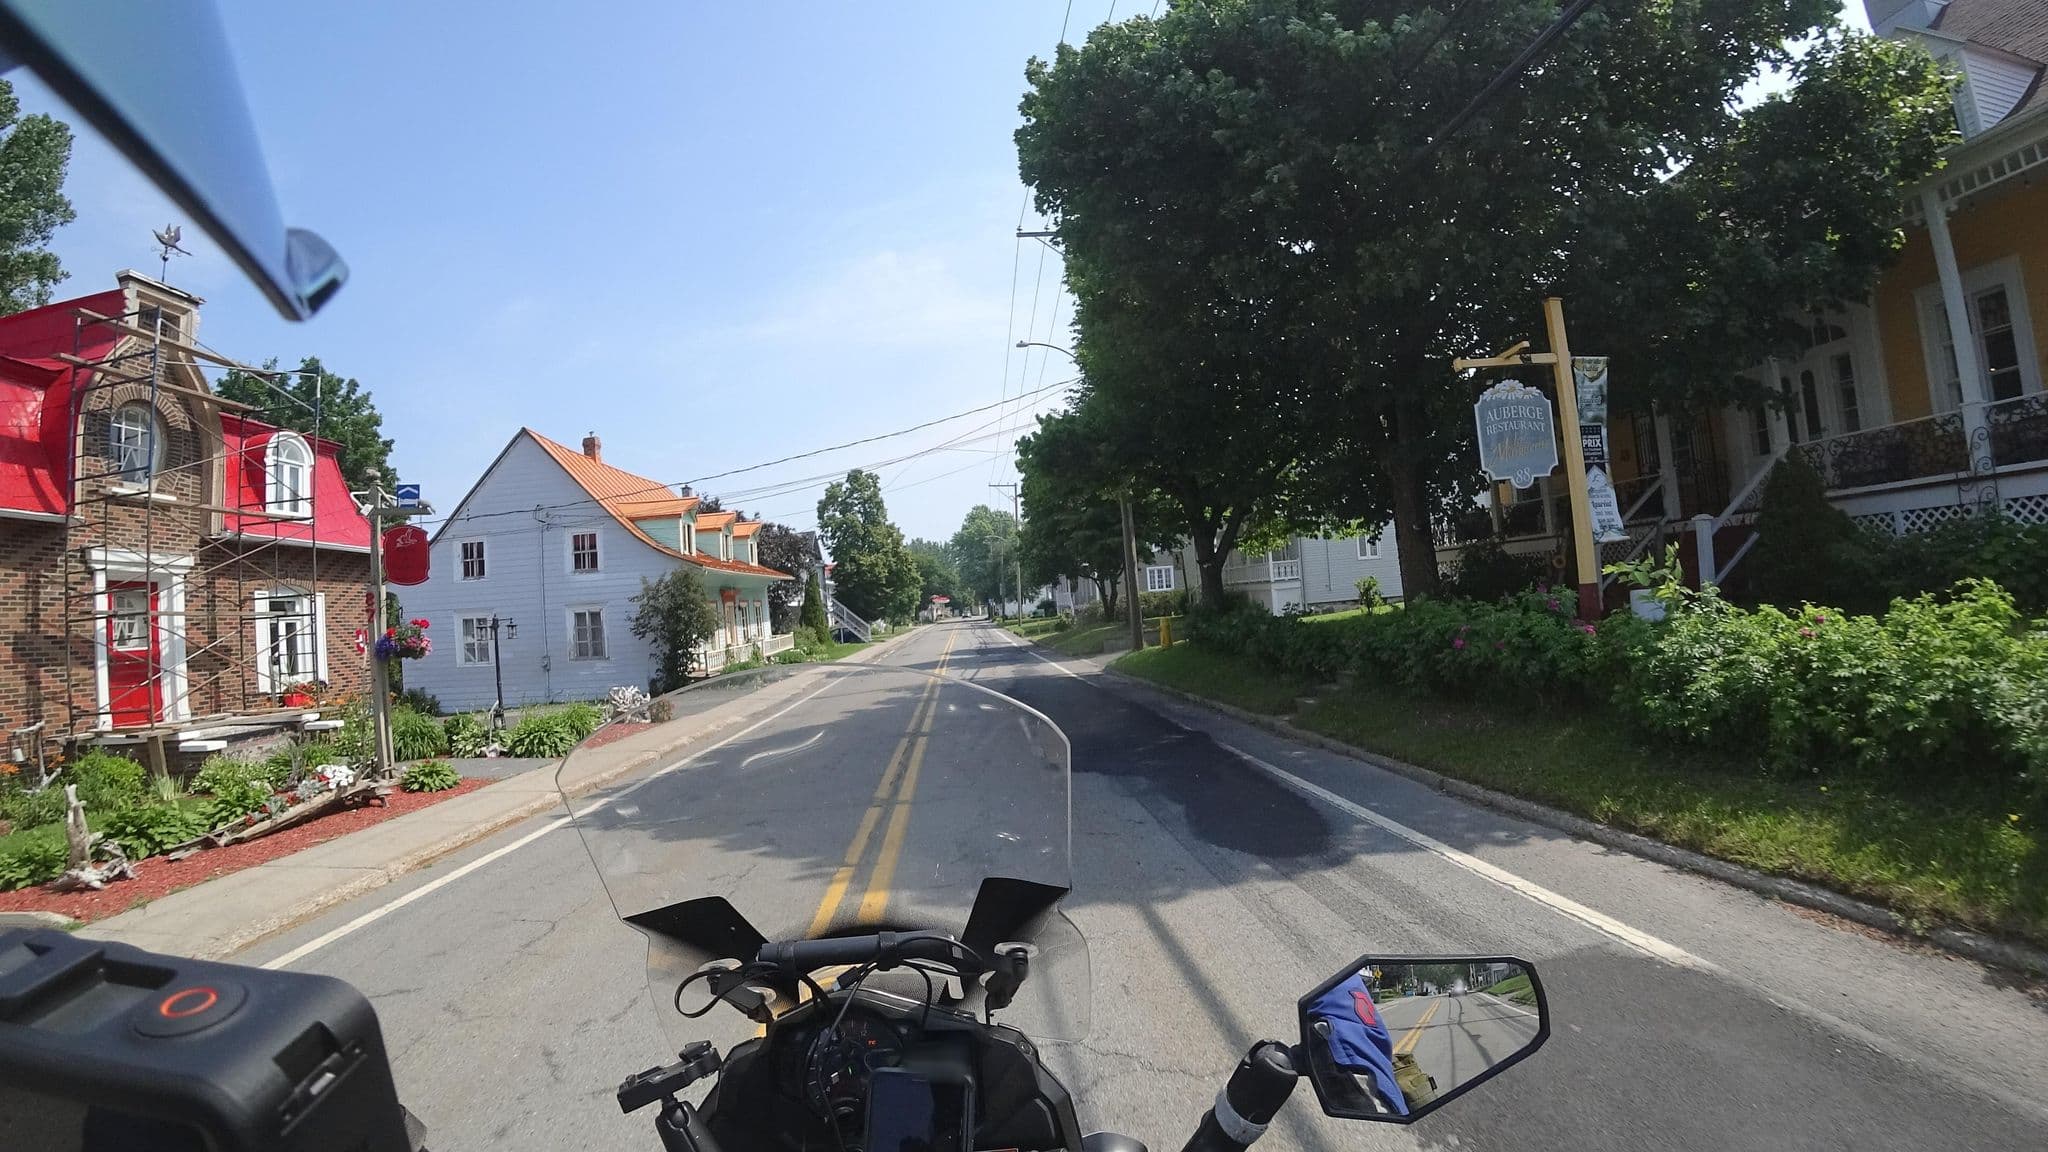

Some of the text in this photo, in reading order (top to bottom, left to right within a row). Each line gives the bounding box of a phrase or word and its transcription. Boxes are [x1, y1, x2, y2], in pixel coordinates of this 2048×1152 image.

[1486, 405, 1545, 424] AUBERGE
[1486, 420, 1546, 436] RESTAURANT
[1582, 438, 1602, 448] PRIX
[1515, 467, 1531, 484] 88
